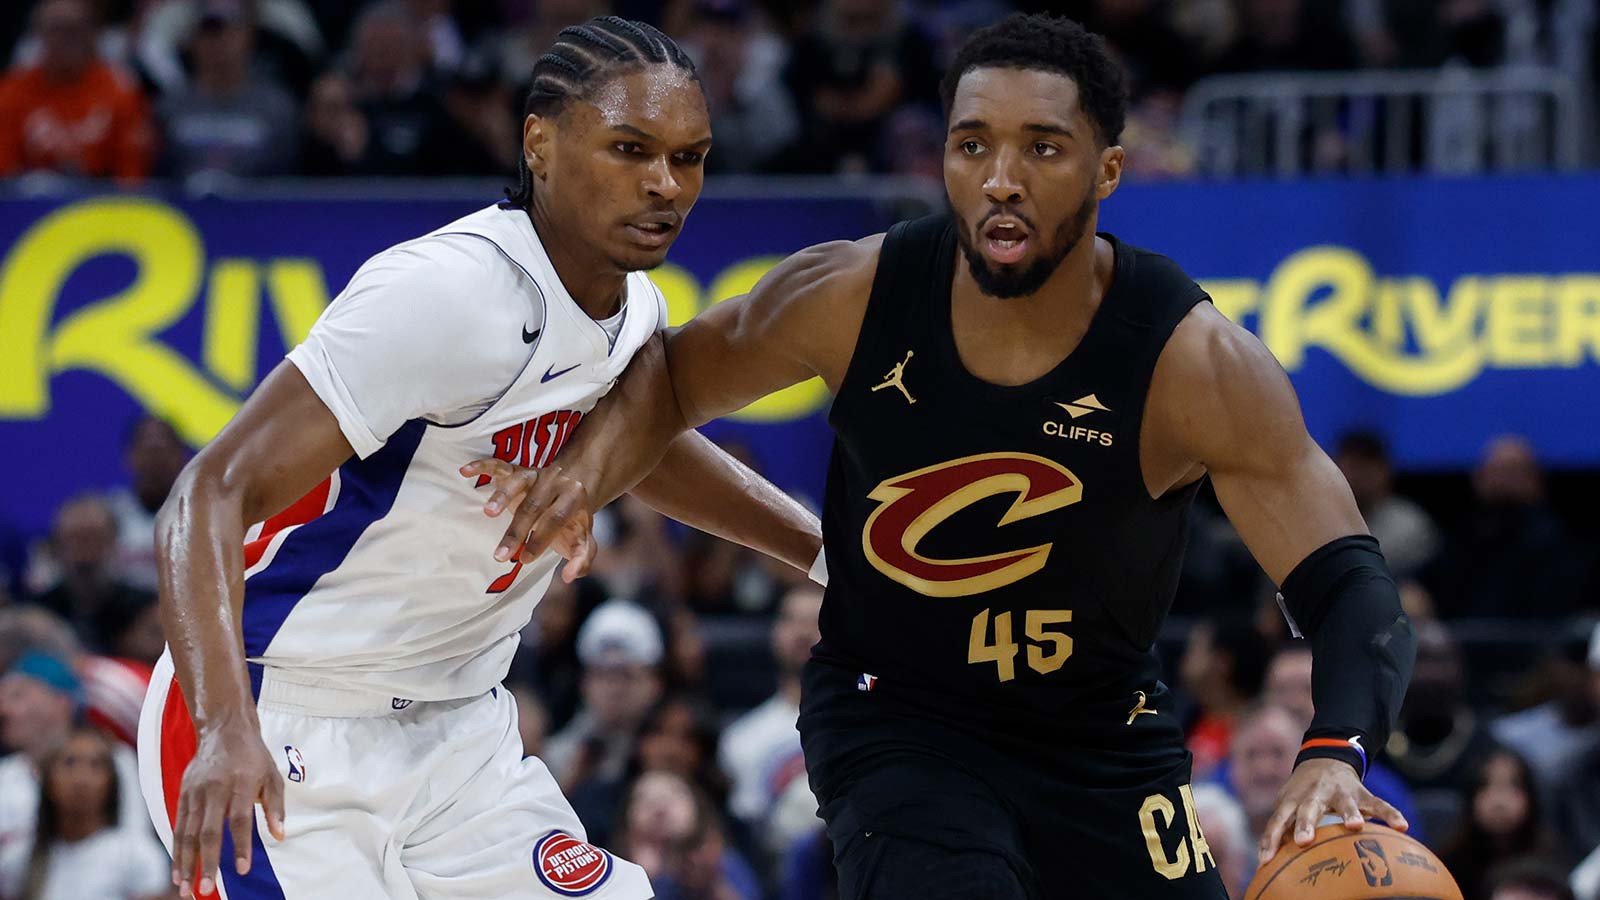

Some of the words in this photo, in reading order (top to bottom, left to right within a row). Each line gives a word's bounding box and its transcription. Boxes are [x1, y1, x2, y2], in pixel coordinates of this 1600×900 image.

[1042, 421, 1113, 447] CLIFFS
[862, 451, 1083, 598] C
[968, 607, 1074, 682] 45
[547, 843, 591, 868] DETROIT
[553, 851, 599, 879] PISTONS
